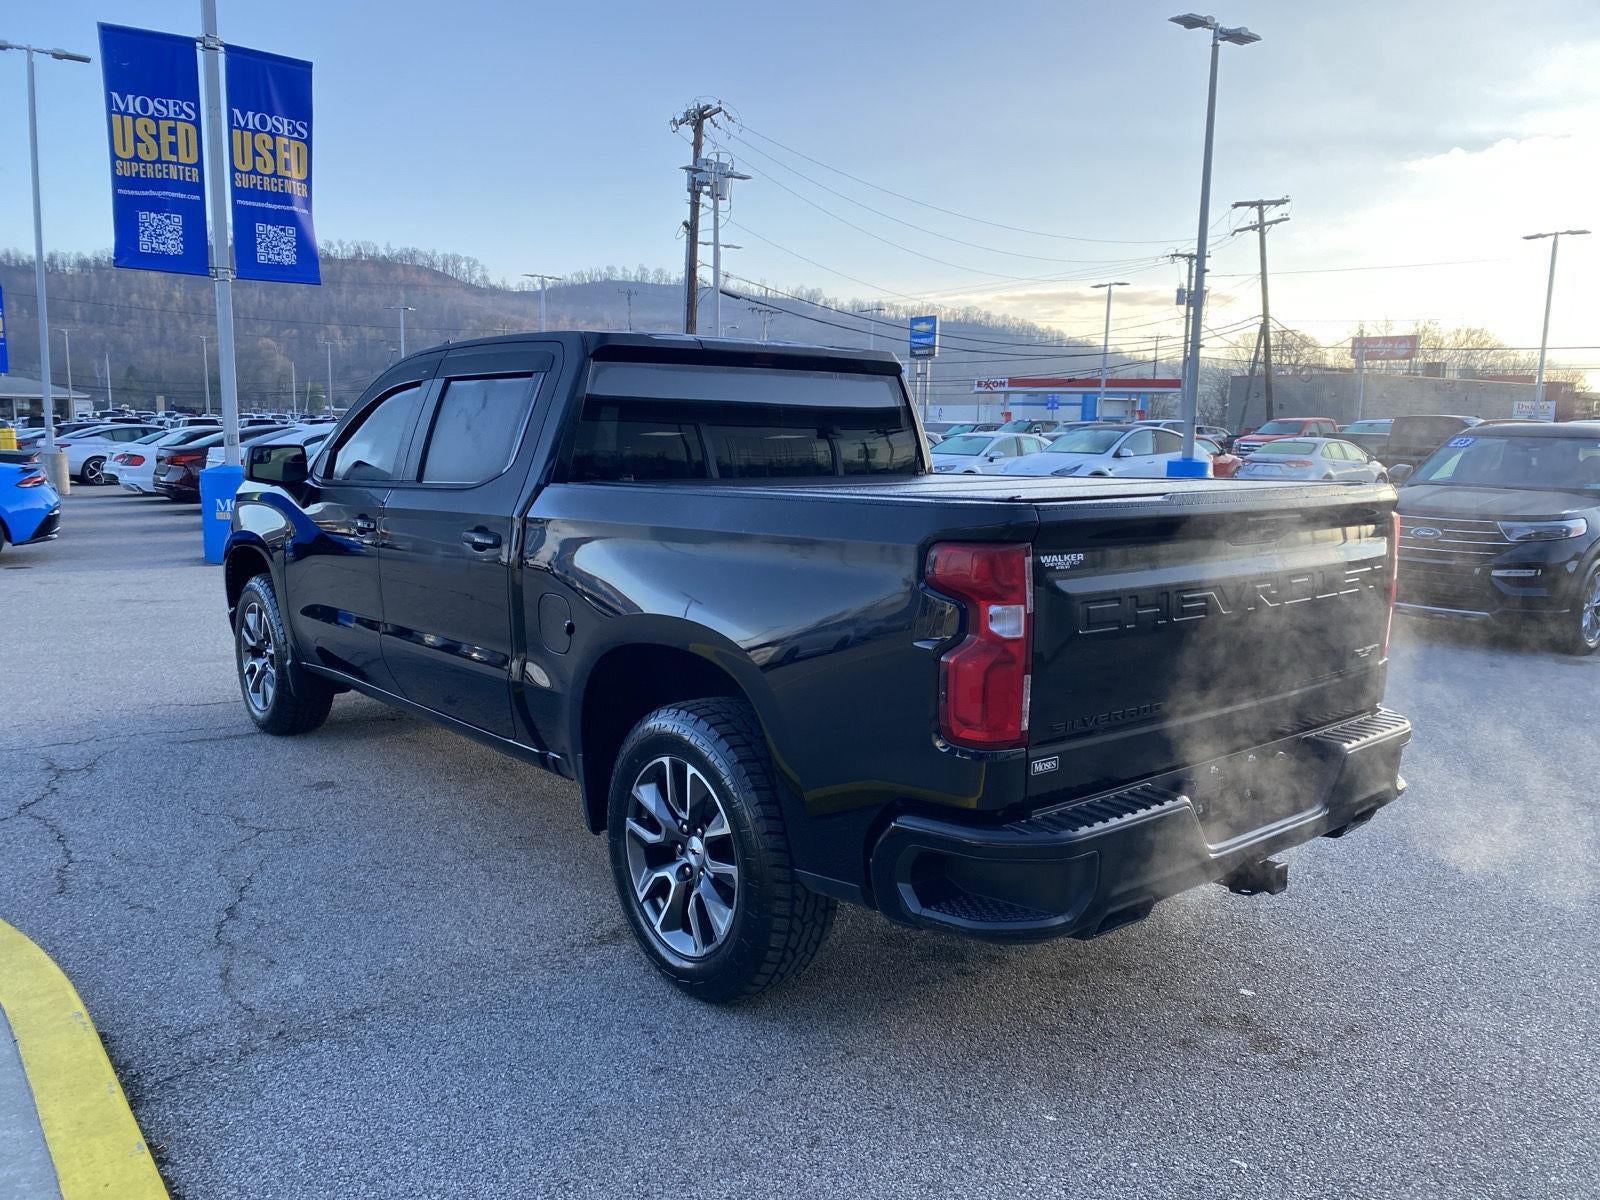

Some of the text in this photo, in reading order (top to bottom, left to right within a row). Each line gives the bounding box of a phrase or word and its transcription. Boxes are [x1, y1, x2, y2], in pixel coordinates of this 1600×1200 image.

[110, 91, 196, 121] MOSES
[232, 108, 308, 140] MOSES
[111, 113, 198, 164] USED
[232, 128, 308, 180] USED
[115, 160, 200, 183] SUPERCENTER
[234, 172, 308, 198] SUPERCENTER
[117, 188, 201, 201] mosesusedsupercenter.com
[976, 378, 1006, 391] EXXON
[1039, 553, 1084, 564] WALKER
[1079, 565, 1383, 634] CHEVROLET
